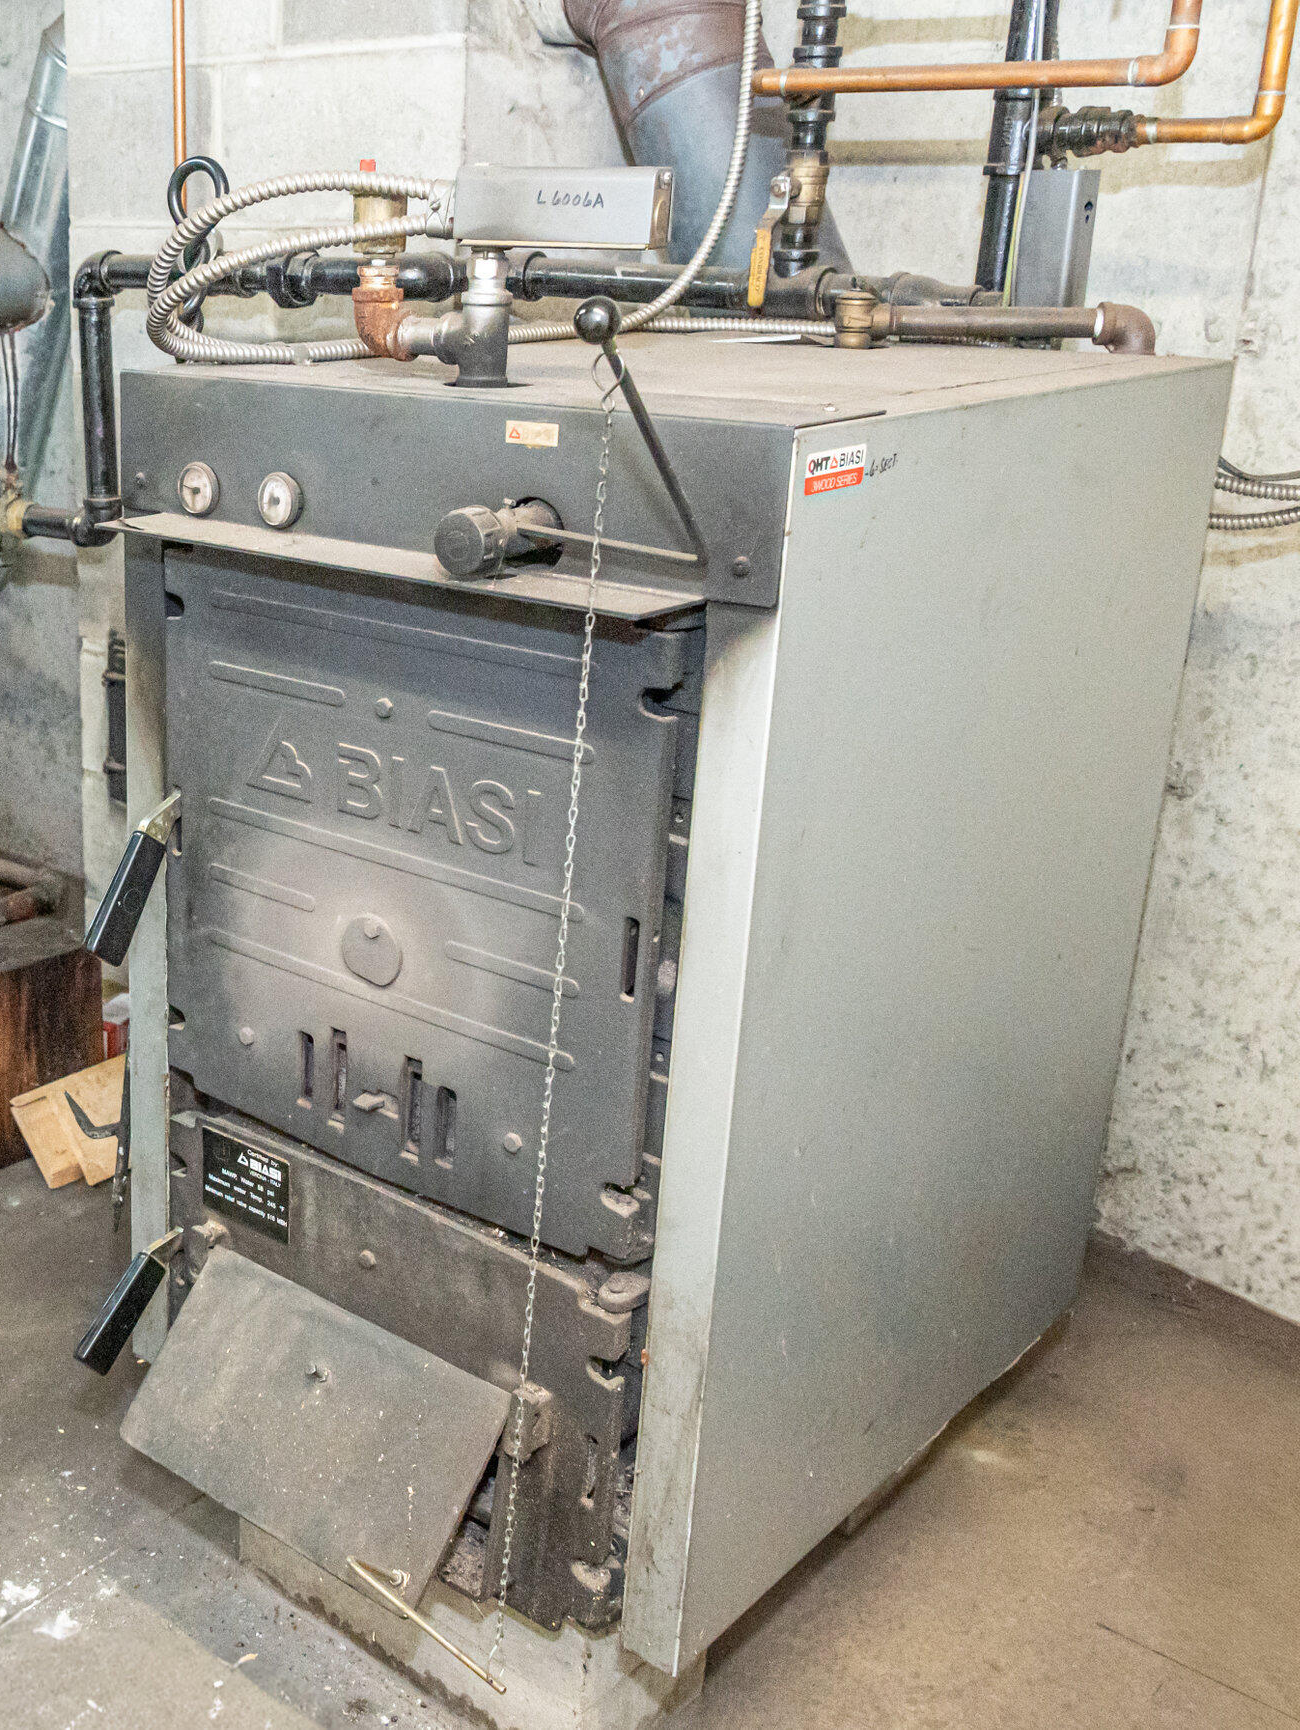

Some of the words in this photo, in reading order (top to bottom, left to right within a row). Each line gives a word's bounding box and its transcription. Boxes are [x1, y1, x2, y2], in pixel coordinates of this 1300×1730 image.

[808, 456, 831, 475] QHT
[839, 449, 864, 467] BIASI
[836, 472, 858, 487] SERIES
[338, 743, 542, 867] BIASI
[249, 1158, 282, 1181] BIASI
[208, 1172, 231, 1188] Maximum
[270, 1179, 282, 1188] ITALY
